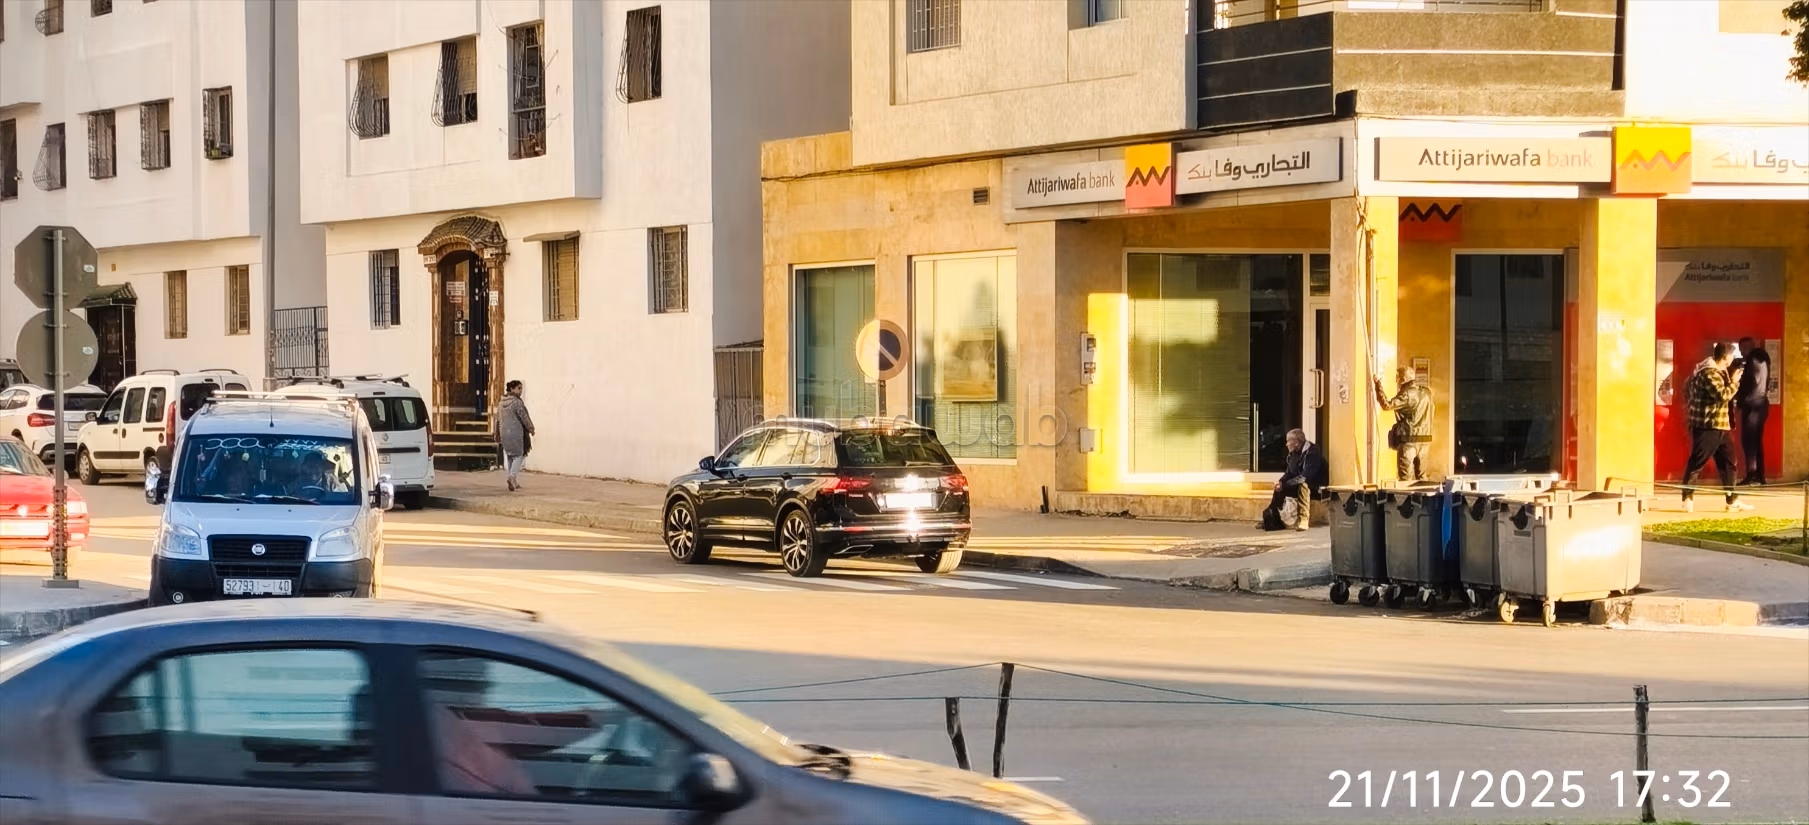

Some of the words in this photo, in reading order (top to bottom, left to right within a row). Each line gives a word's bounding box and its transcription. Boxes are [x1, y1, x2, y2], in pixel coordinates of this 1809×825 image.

[1417, 147, 1542, 172] Attijariwafa
[1546, 148, 1594, 168] bank
[1026, 171, 1087, 198] Attijariwafa
[1088, 169, 1116, 189] bank
